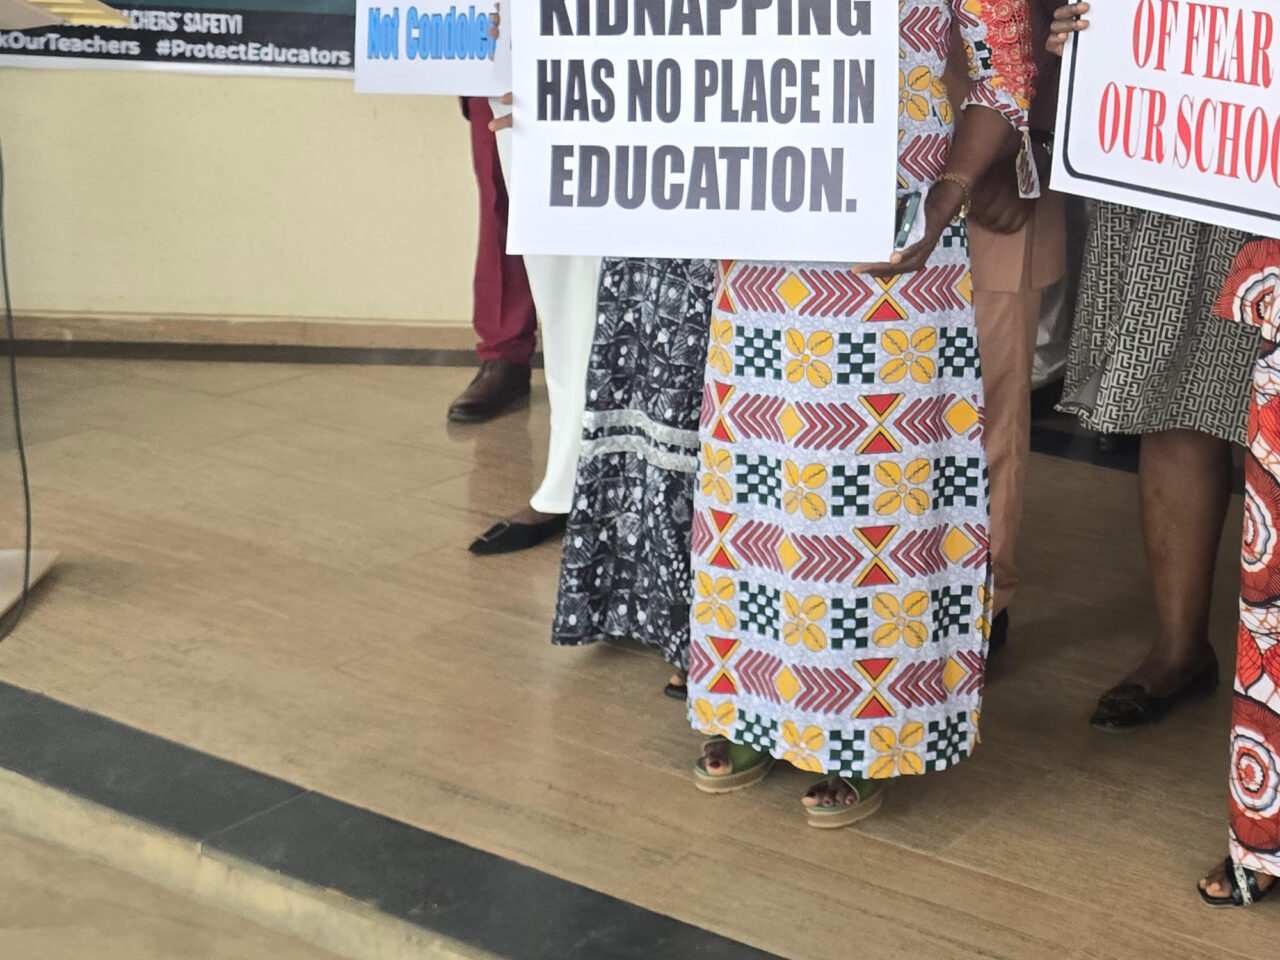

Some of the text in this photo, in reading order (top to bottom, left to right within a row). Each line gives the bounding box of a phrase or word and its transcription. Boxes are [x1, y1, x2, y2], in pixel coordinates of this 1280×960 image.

[156, 38, 352, 66] #ProtectEducators
[183, 11, 243, 34] SAFETY!
[367, 7, 399, 60] Not
[1182, 2, 1275, 89] FEAR
[536, 58, 875, 124] HAS NO PLACE IN
[1098, 81, 1166, 164] OUR
[549, 144, 857, 213] EDUCATION.
